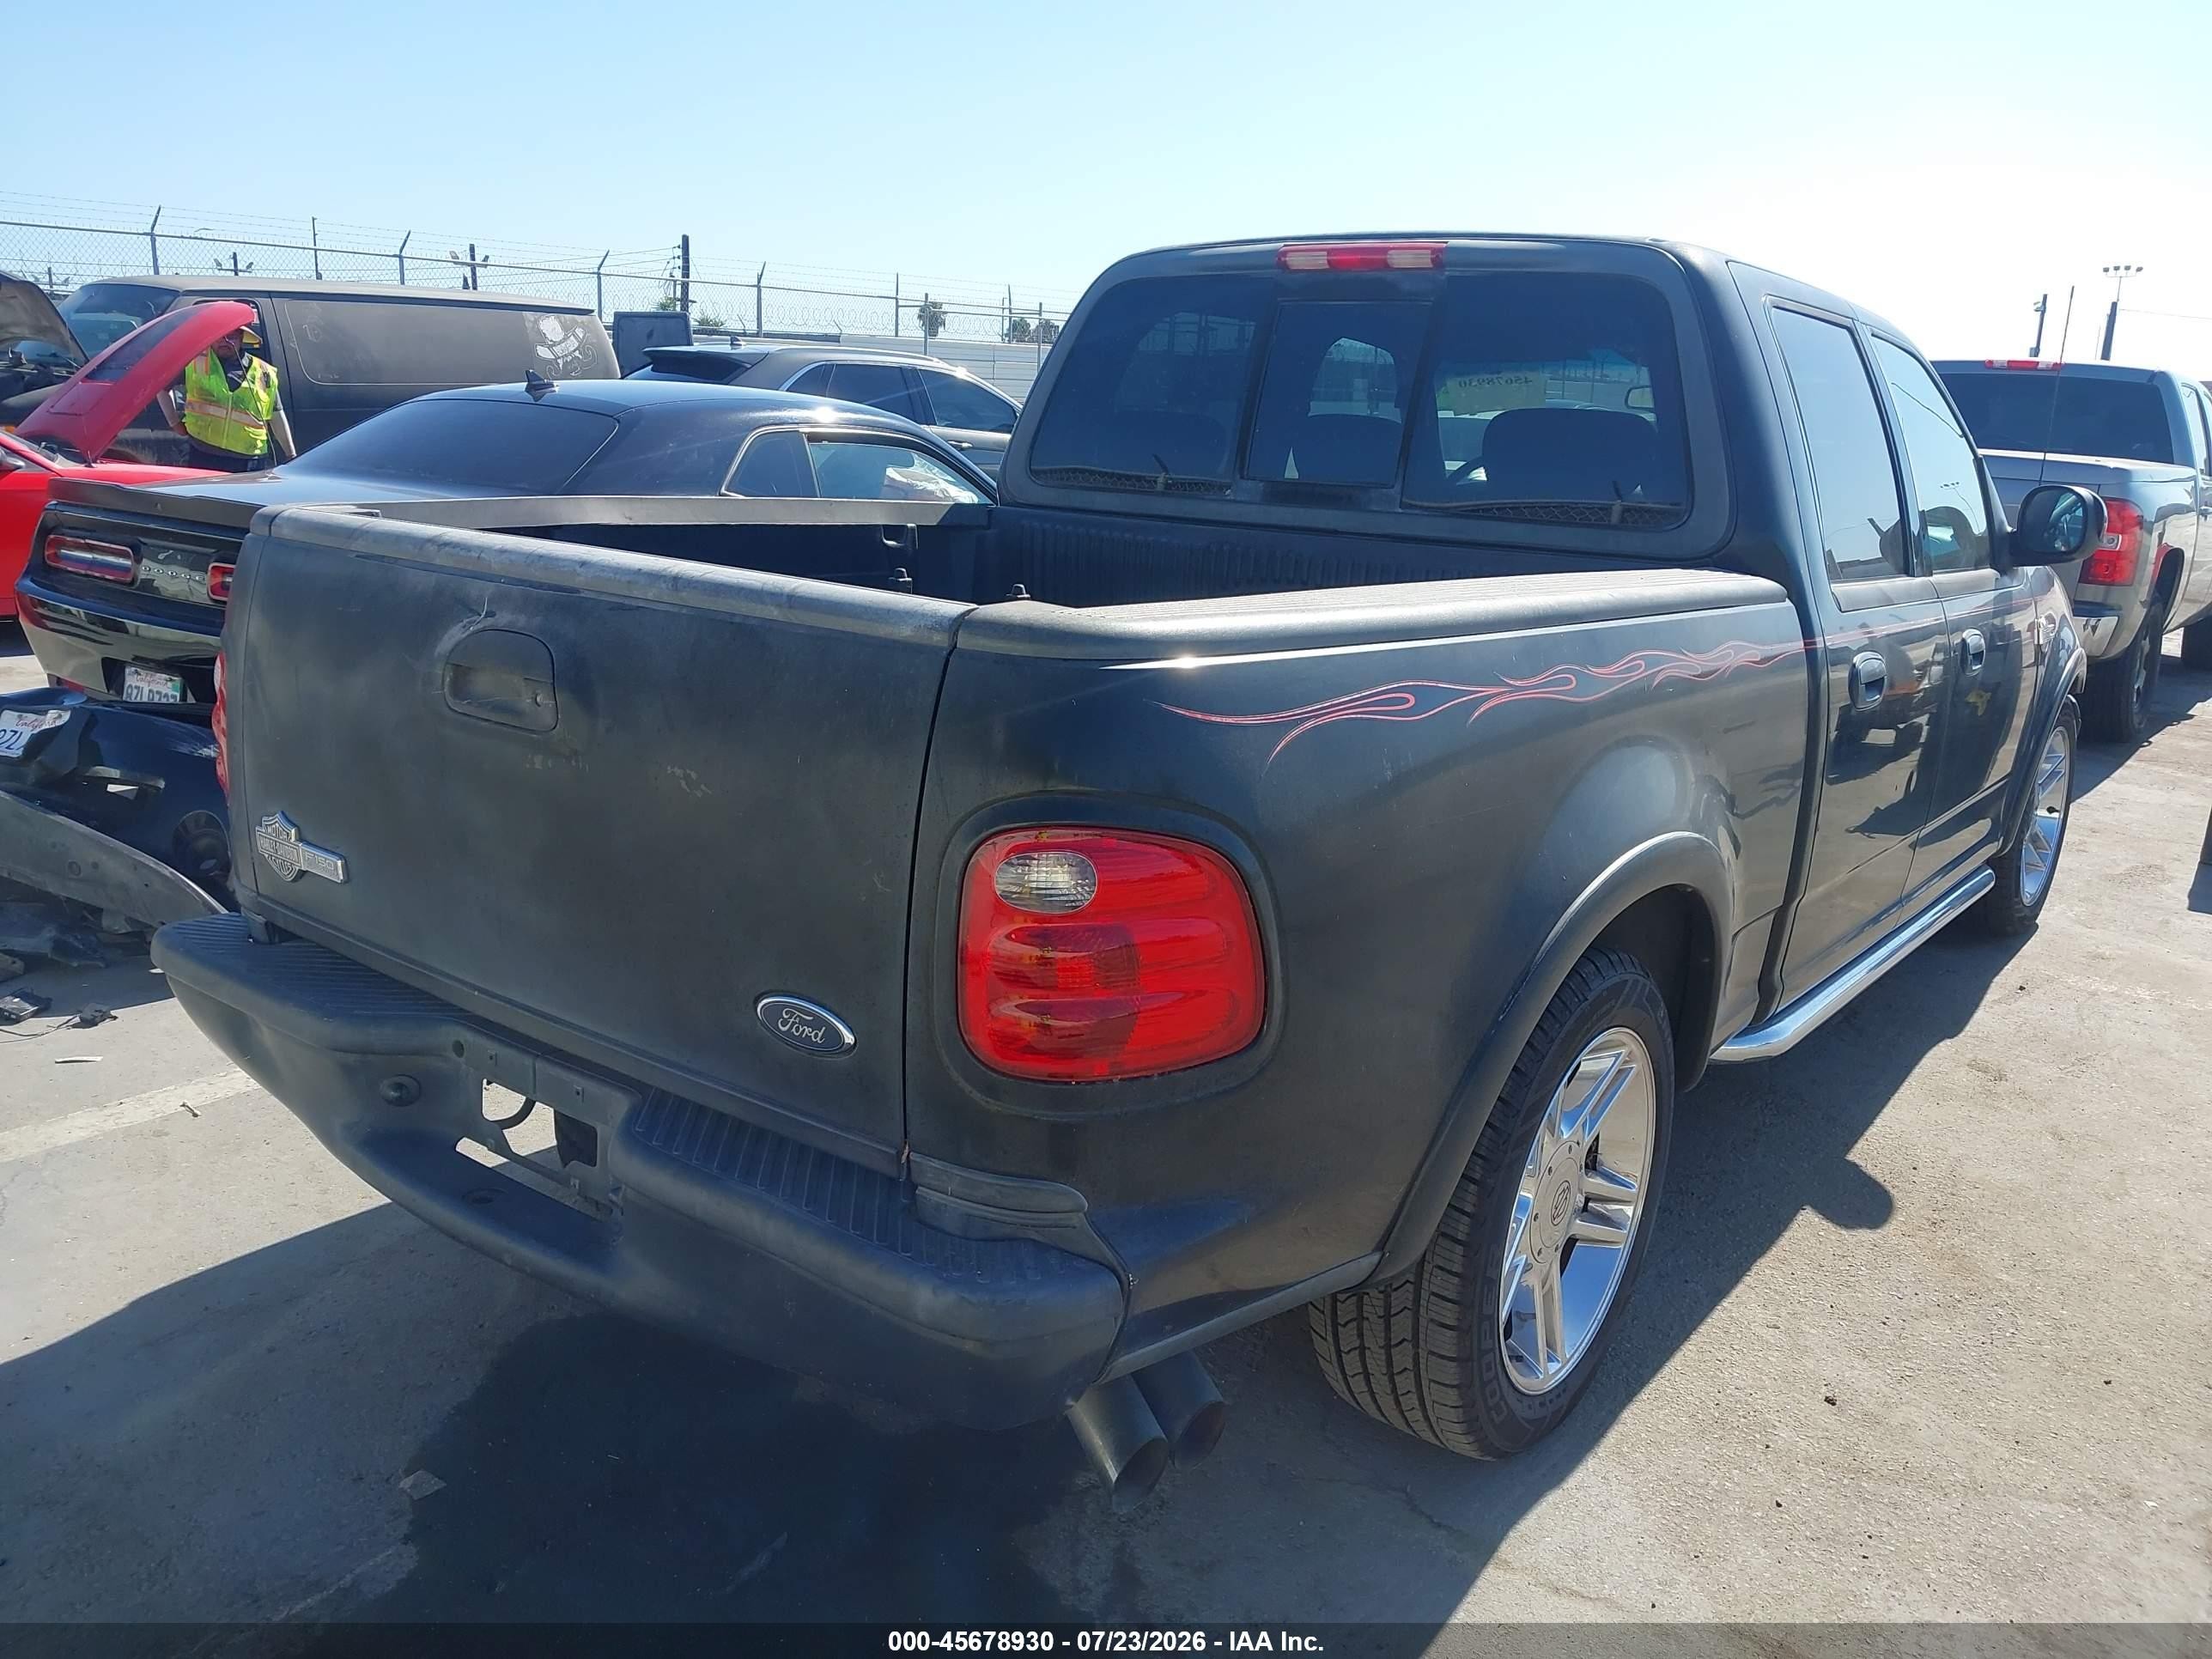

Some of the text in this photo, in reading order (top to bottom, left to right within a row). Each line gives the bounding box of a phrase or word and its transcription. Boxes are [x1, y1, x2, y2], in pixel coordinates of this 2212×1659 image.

[142, 565, 205, 583] DODGE
[778, 1007, 826, 1044] Ford
[1480, 1242, 1509, 1425] COOPER
